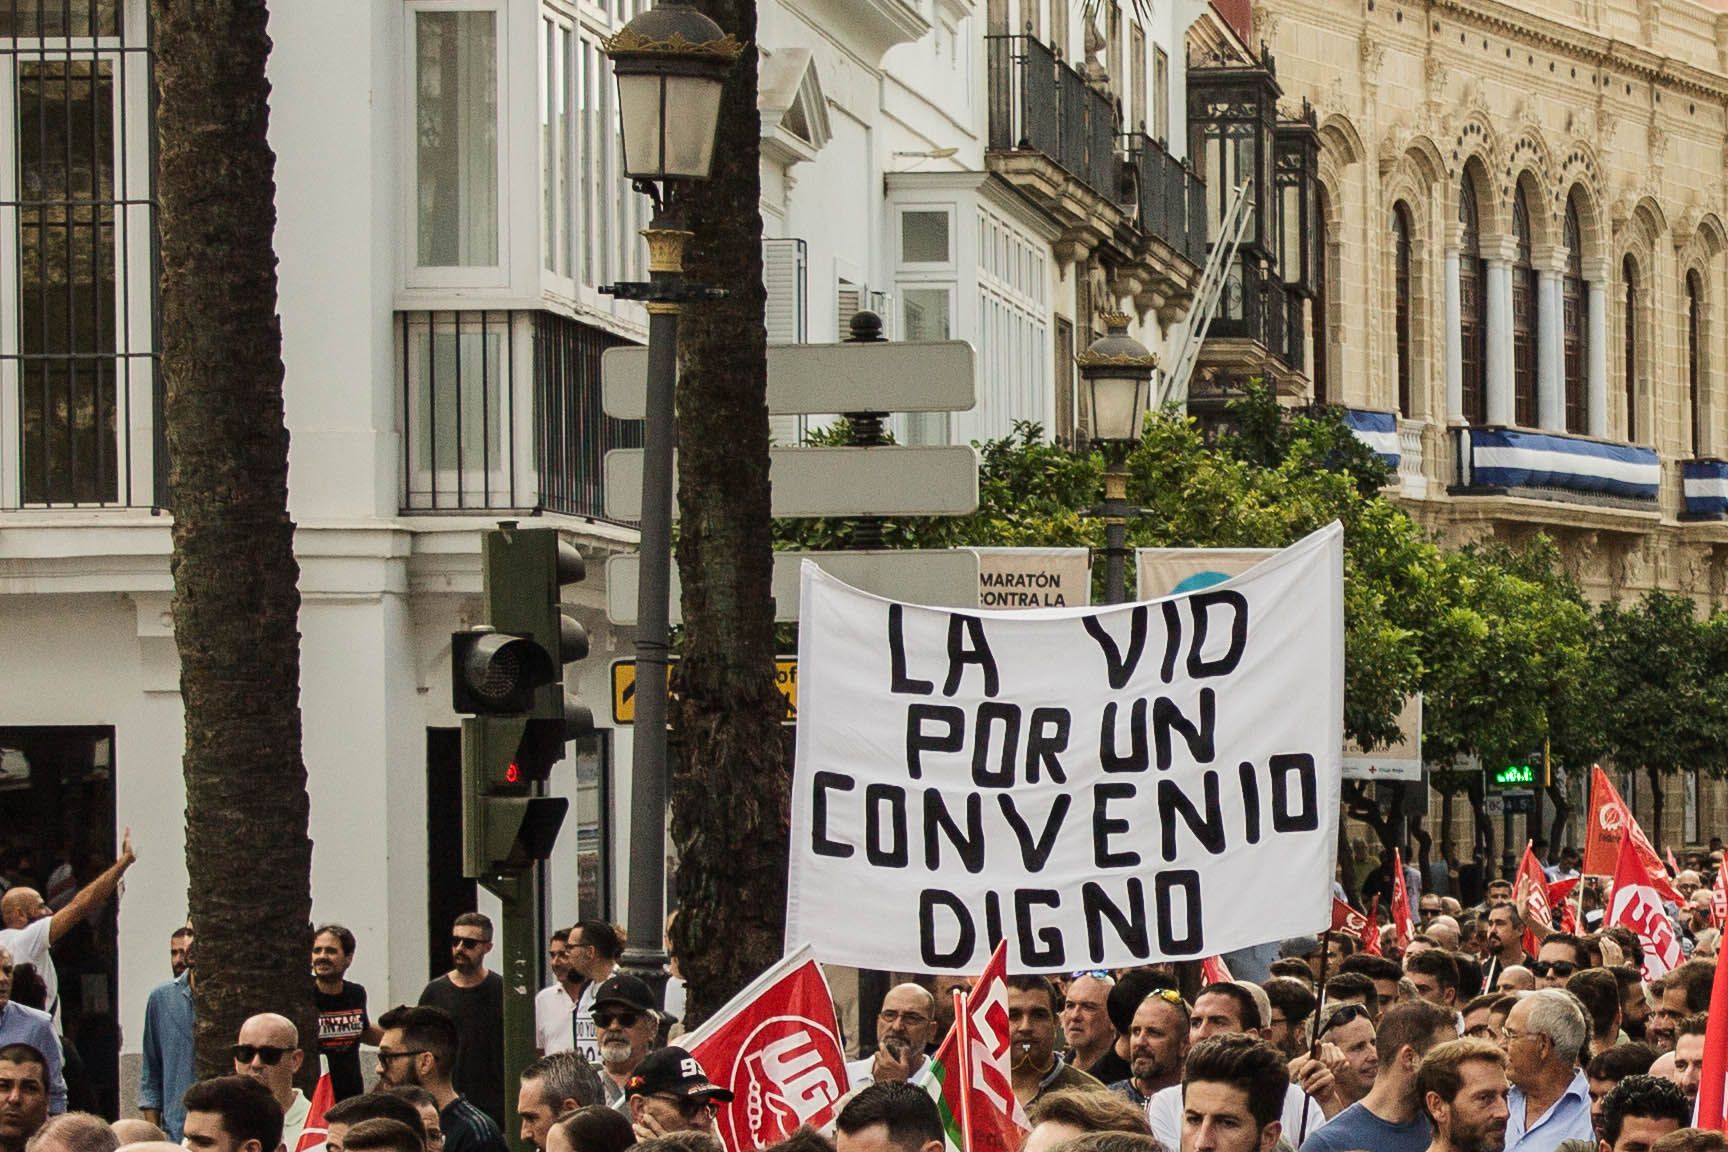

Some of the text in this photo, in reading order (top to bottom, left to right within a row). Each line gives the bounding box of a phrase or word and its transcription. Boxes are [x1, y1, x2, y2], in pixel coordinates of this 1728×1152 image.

[980, 571, 1061, 588] MARATÓN
[980, 592, 1066, 607] ONTRA LA
[889, 604, 998, 697] LA
[907, 688, 1215, 788] POR UN
[812, 752, 1319, 874] CONVENIO
[918, 869, 1205, 968] DIGNO
